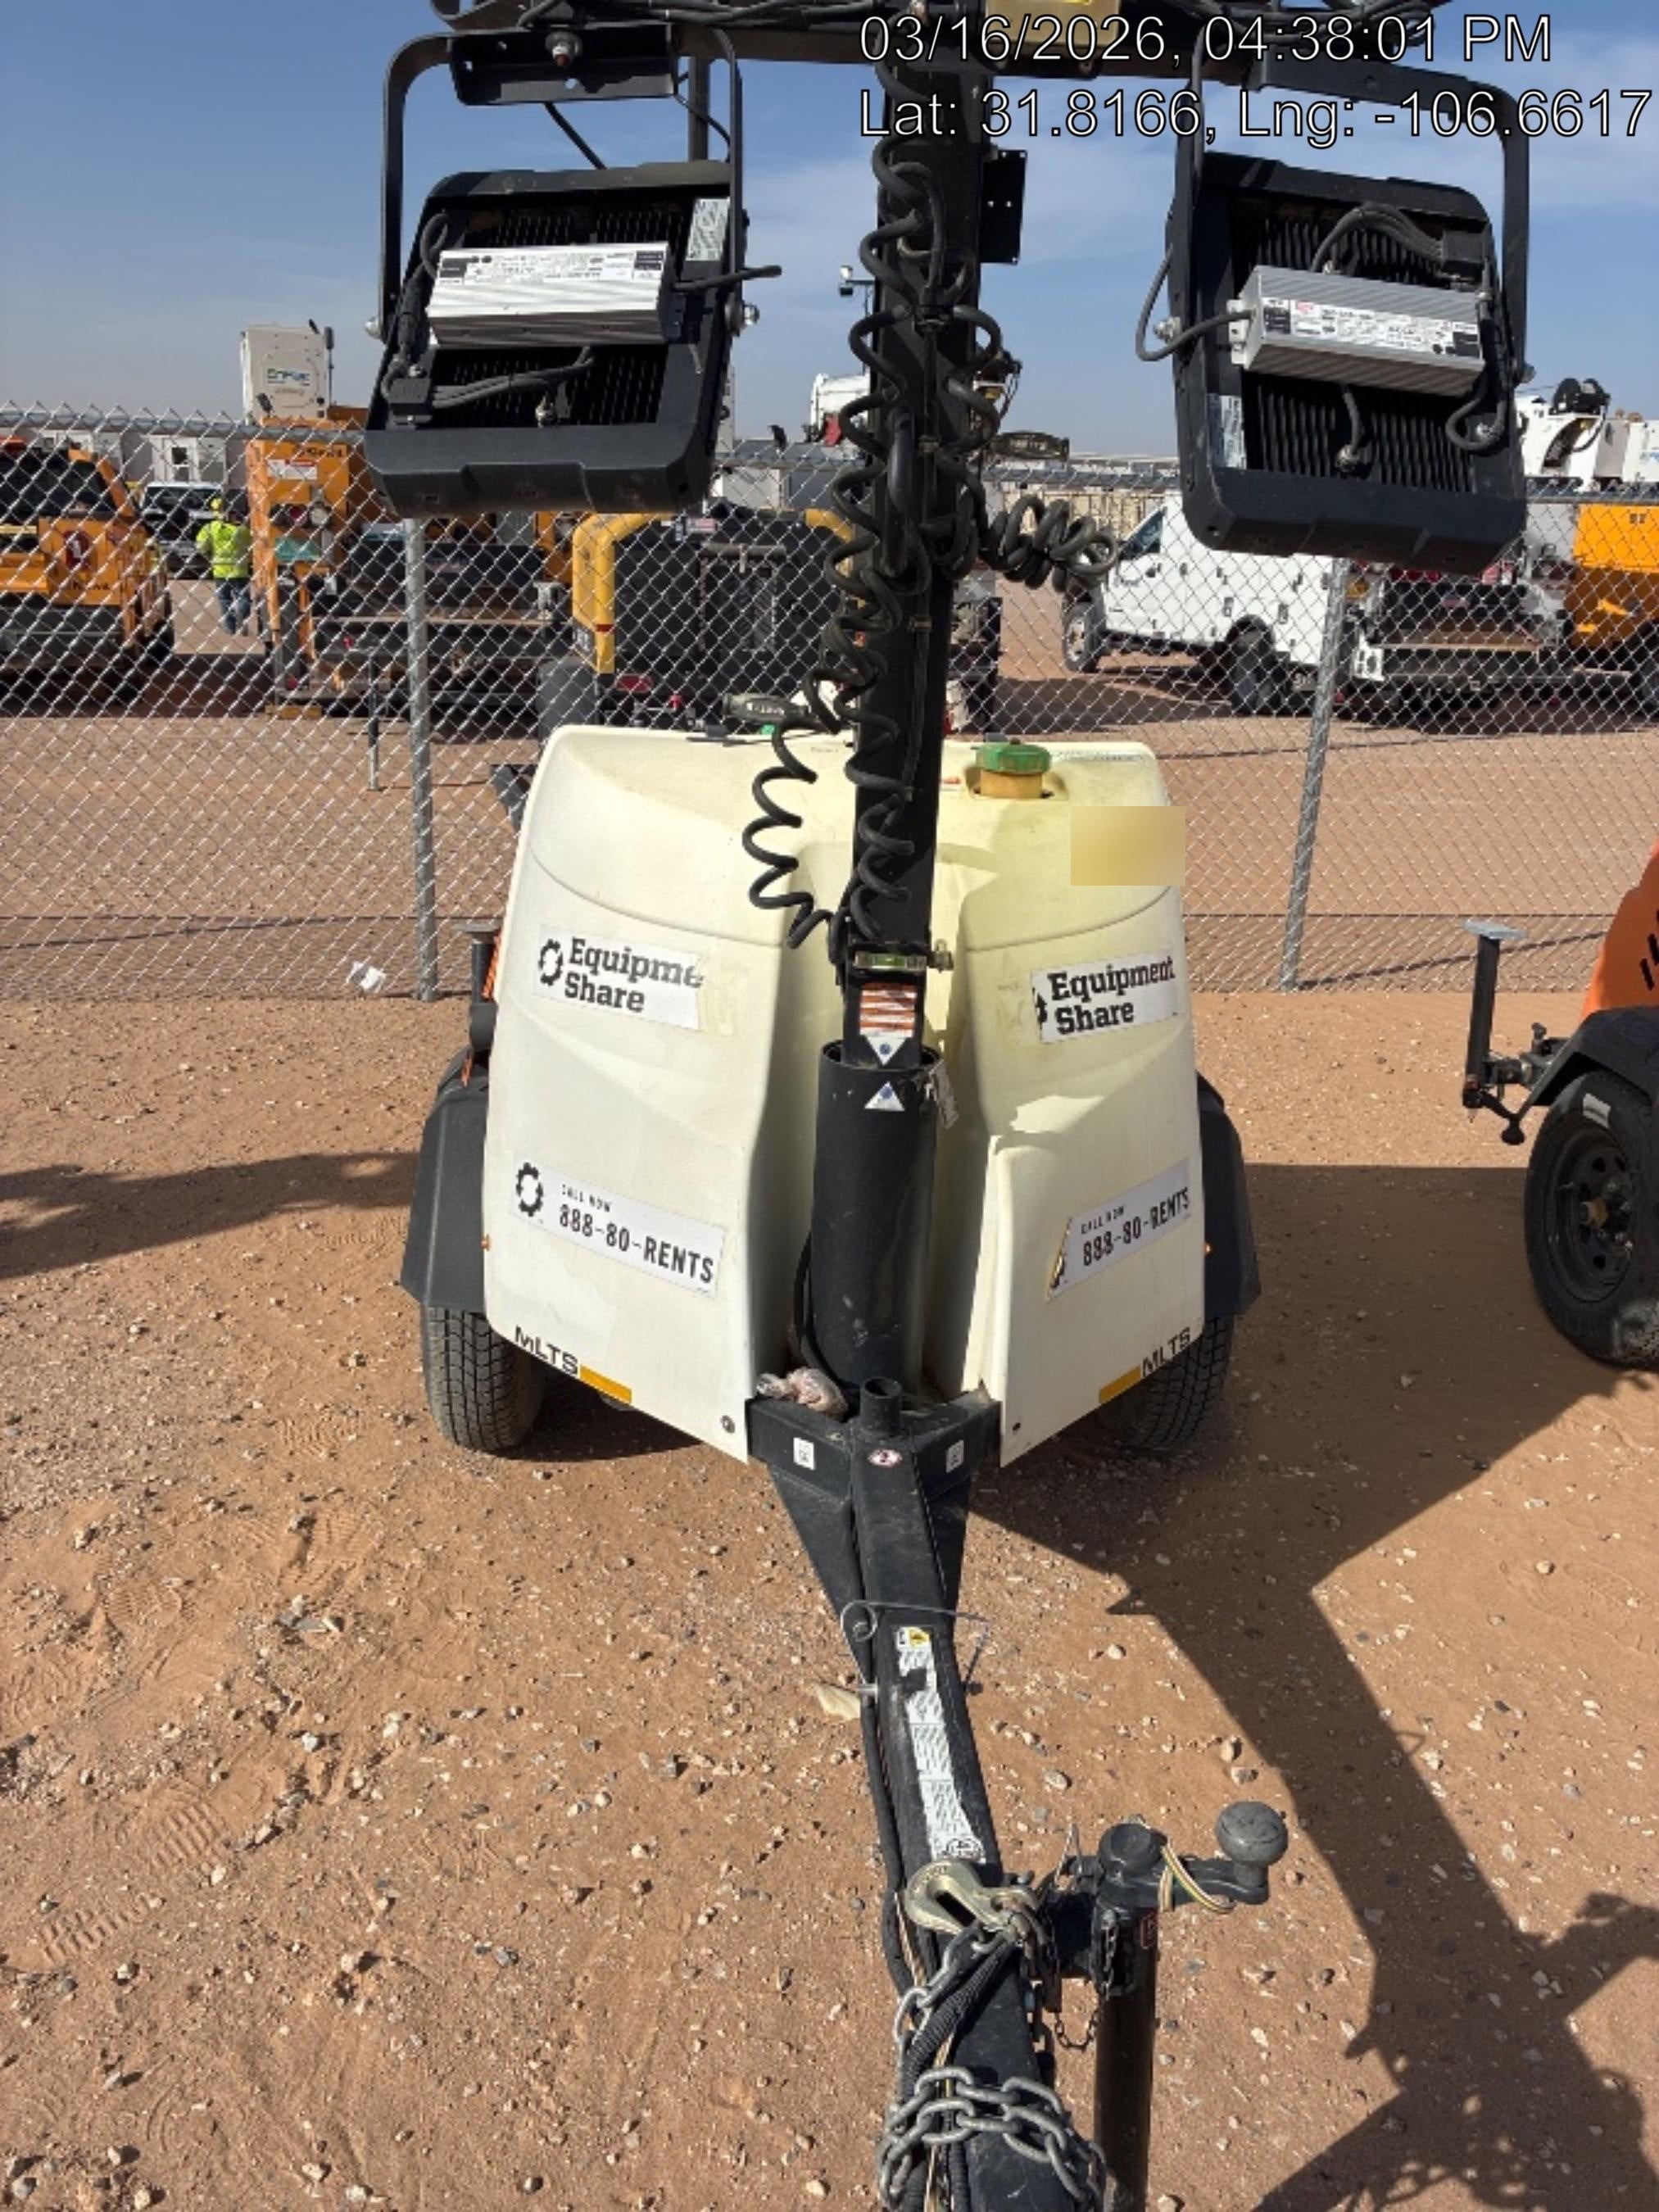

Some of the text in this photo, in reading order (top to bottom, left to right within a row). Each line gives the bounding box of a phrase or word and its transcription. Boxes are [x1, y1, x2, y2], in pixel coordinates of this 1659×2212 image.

[564, 972, 645, 1013] Share
[1047, 955, 1176, 1004] Equipment
[1054, 1002, 1135, 1035] Share
[559, 1203, 715, 1284] 888-80-RENTS
[1081, 1206, 1125, 1235] CALL NOW
[1082, 1186, 1190, 1267] 888-80-RENTS
[514, 1325, 578, 1375] MLTS
